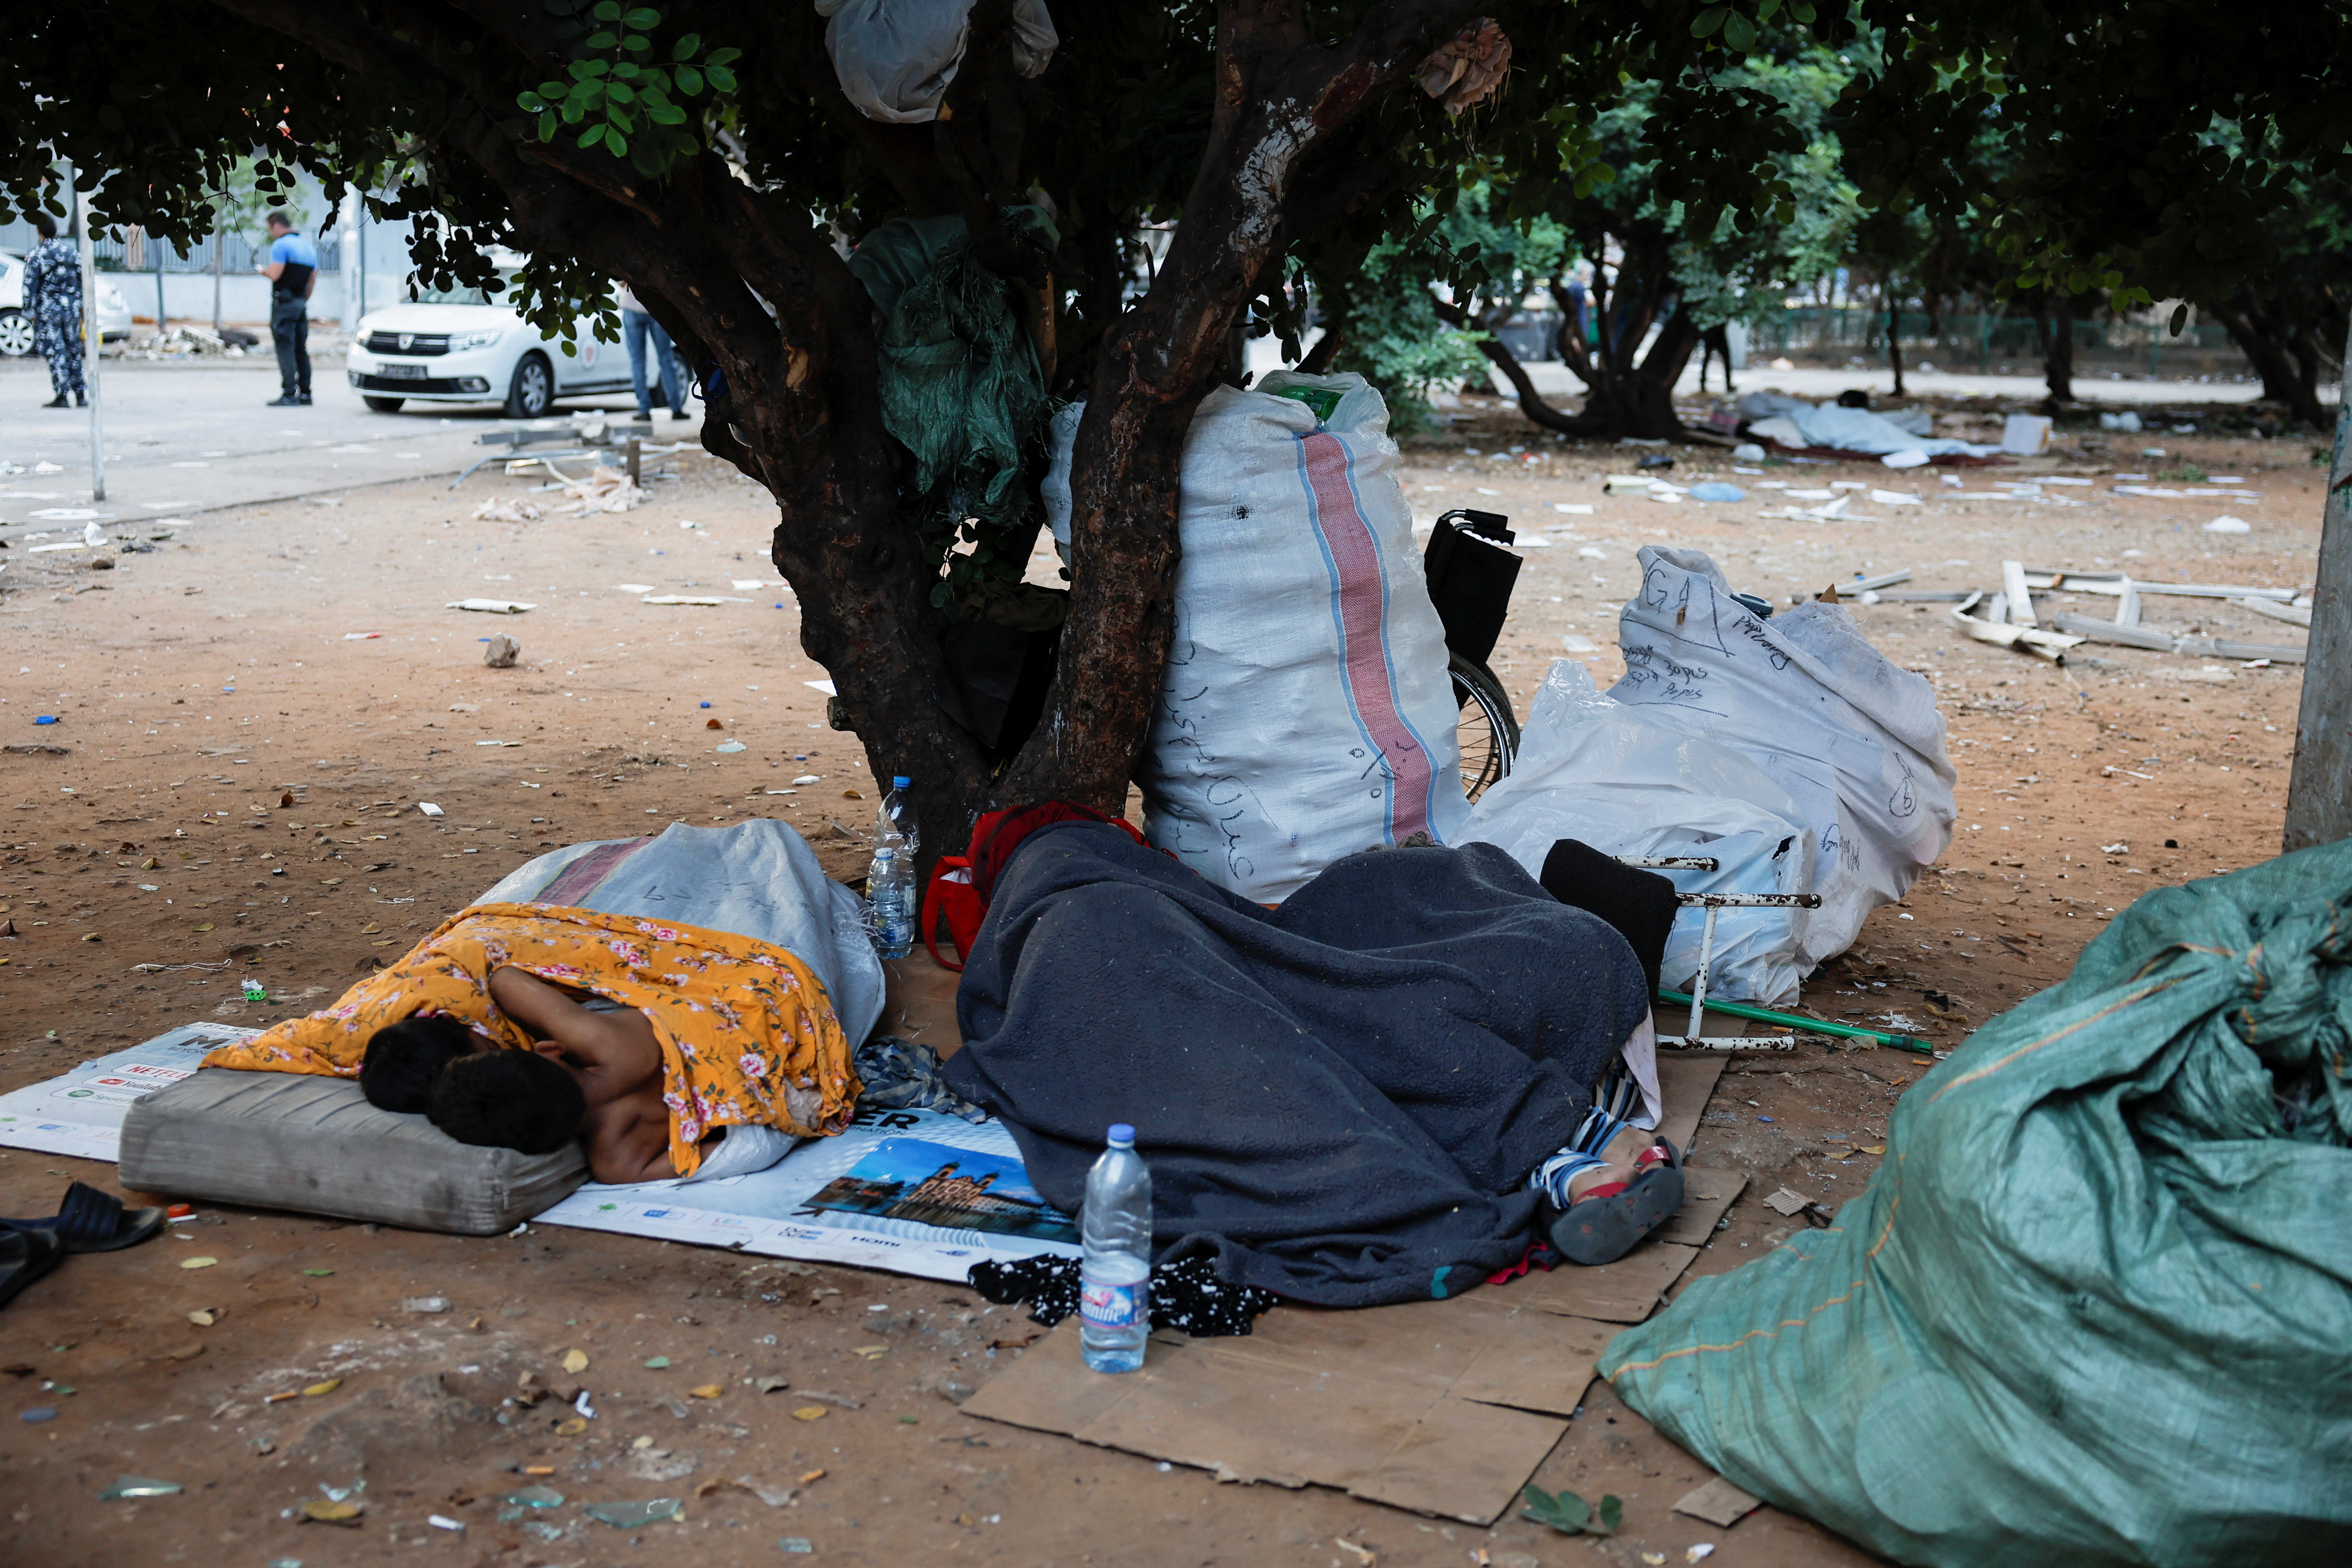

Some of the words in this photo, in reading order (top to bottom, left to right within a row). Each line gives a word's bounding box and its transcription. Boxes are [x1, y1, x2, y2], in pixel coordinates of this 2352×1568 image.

[127, 1066, 189, 1079] NETFLI
[122, 1081, 162, 1091] YouTub
[849, 1108, 921, 1130] ER
